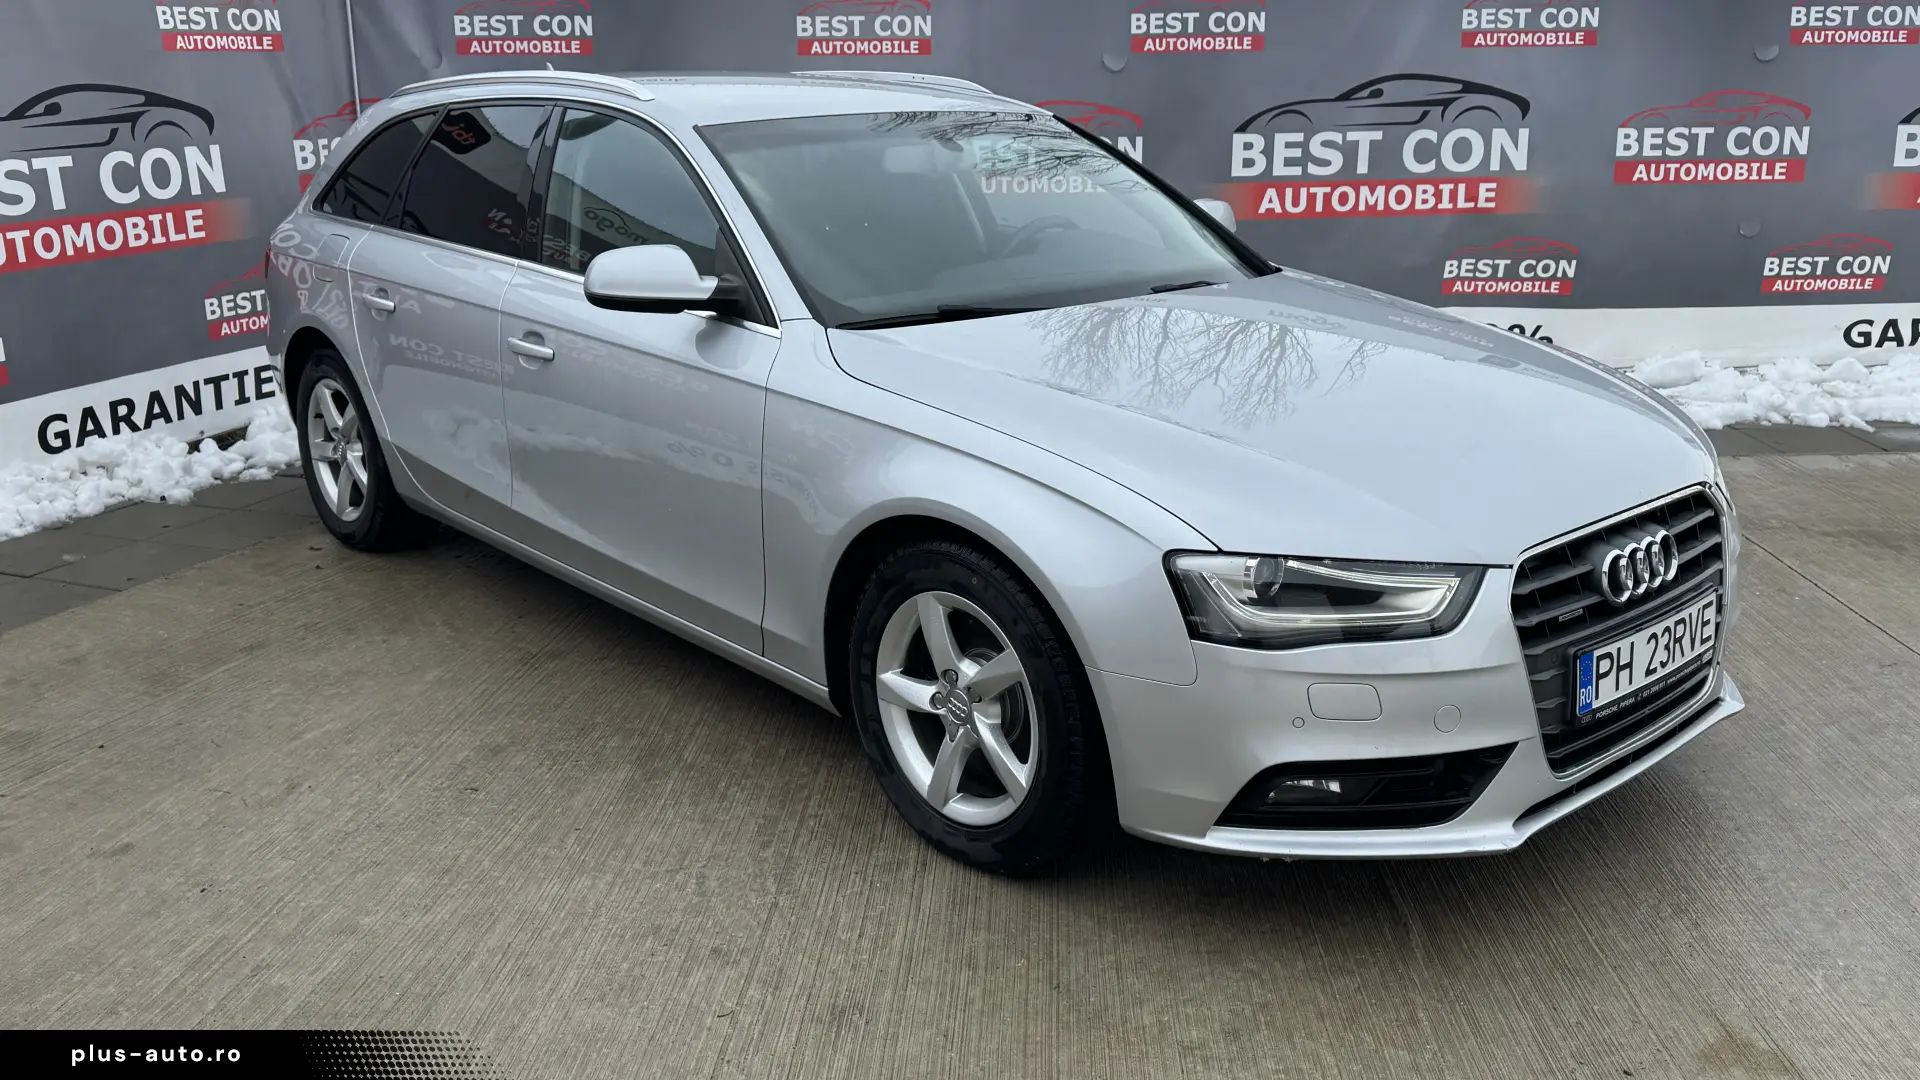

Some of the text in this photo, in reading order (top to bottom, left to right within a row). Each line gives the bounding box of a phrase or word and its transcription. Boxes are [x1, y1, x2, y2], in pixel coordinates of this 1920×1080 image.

[156, 6, 281, 31] BEST CON
[454, 15, 593, 36] BEST CON
[796, 15, 932, 36] BEST CON
[1130, 12, 1265, 34] BEST CON
[1462, 7, 1599, 29] BEST CON
[1791, 5, 1920, 26] BEST CON
[176, 34, 273, 50] AUTOMOBILE
[470, 40, 580, 54] AUTOMOBILE
[810, 40, 919, 54] AUTOMOBILE
[1144, 36, 1252, 51] AUTOMOBILE
[1474, 32, 1585, 46] AUTOMOBILE
[1802, 31, 1908, 43] AUTOMOBILE
[1615, 125, 1811, 157] BEST CON
[1231, 127, 1530, 177] BEST CON
[99, 144, 226, 204] CON
[1632, 162, 1788, 182] AUTOMOBILE
[1258, 182, 1497, 214] AUTOMOBILE
[1443, 258, 1577, 279] BEST CON
[1763, 255, 1891, 276] BEST CON
[1452, 281, 1560, 293] AUTOMOBILE
[1772, 277, 1874, 292] AUTOMOBILE
[204, 289, 265, 320] BEST
[37, 364, 277, 455] GARANTIE
[1594, 599, 1714, 701] PH 23RVE
[1580, 685, 1592, 707] RO
